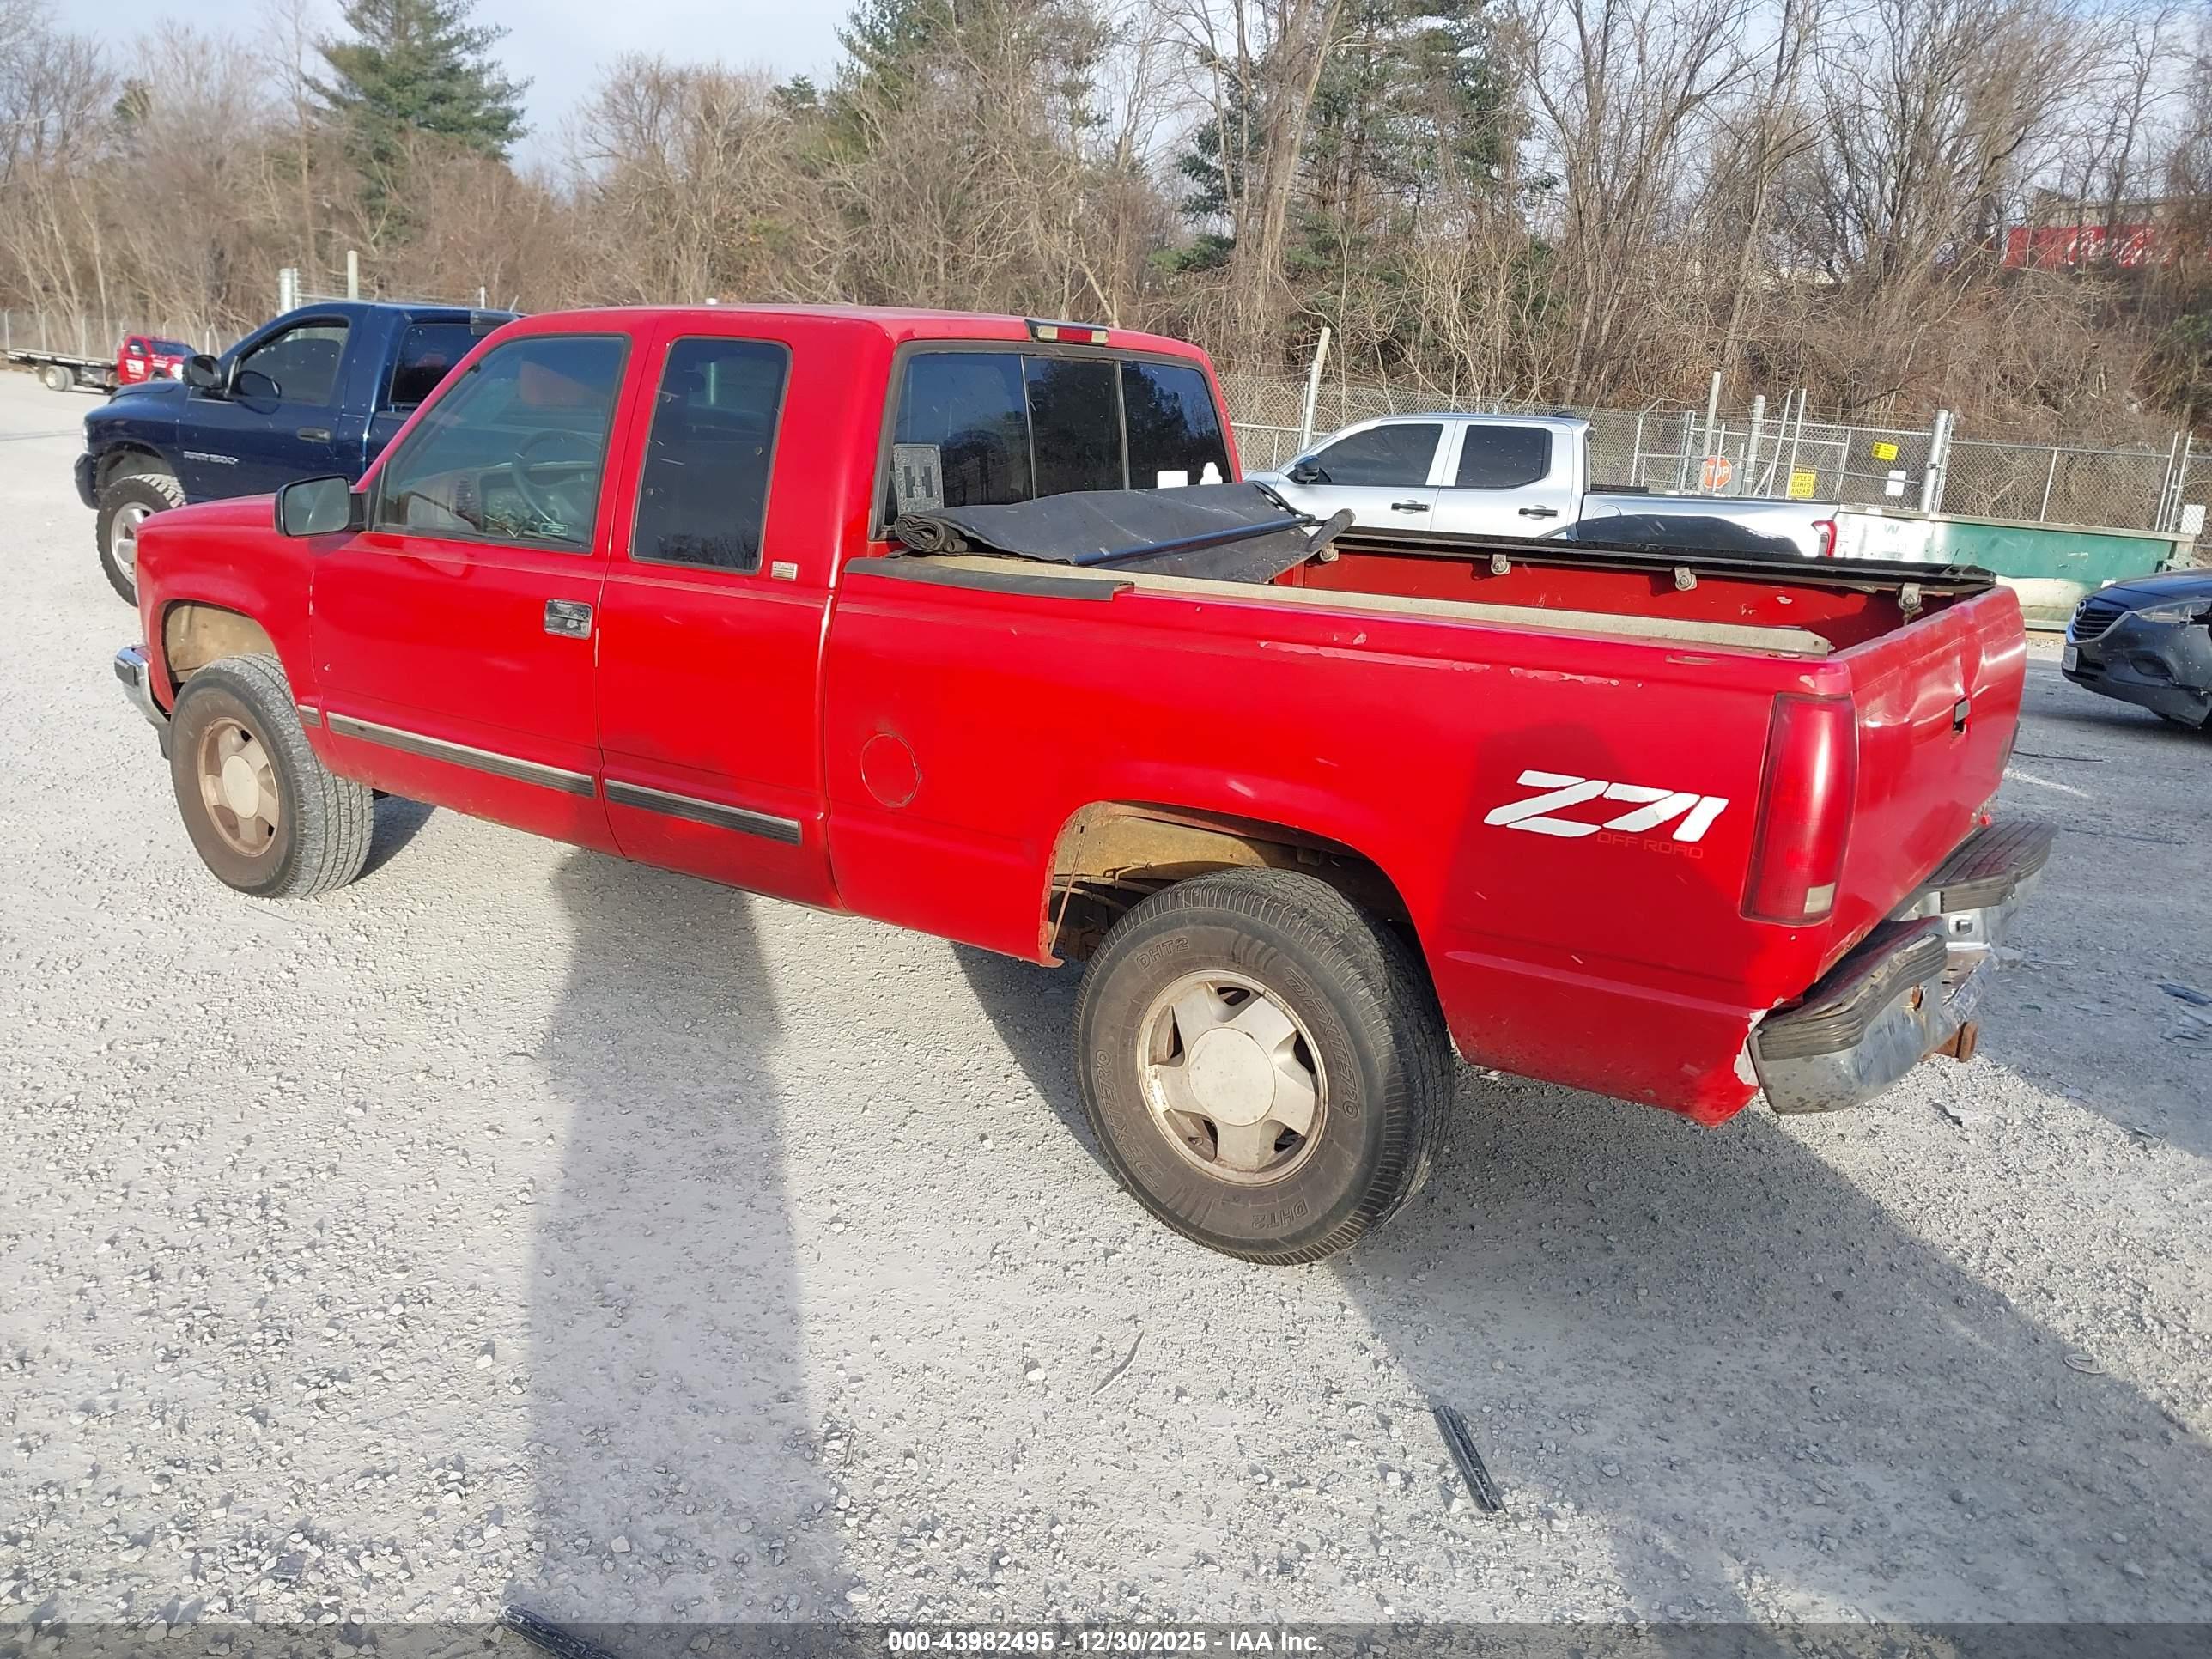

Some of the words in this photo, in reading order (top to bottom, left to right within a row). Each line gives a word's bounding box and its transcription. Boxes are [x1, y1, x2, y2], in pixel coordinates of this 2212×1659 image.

[1483, 769, 1729, 842] Z71
[1596, 832, 1639, 848] OFF
[1643, 838, 1705, 860] ROAD
[1136, 937, 1189, 969] DHT2
[1285, 968, 1359, 1119] DEXTERO
[1095, 1049, 1159, 1189] DEXTERO
[1251, 1200, 1309, 1230] DHT2
